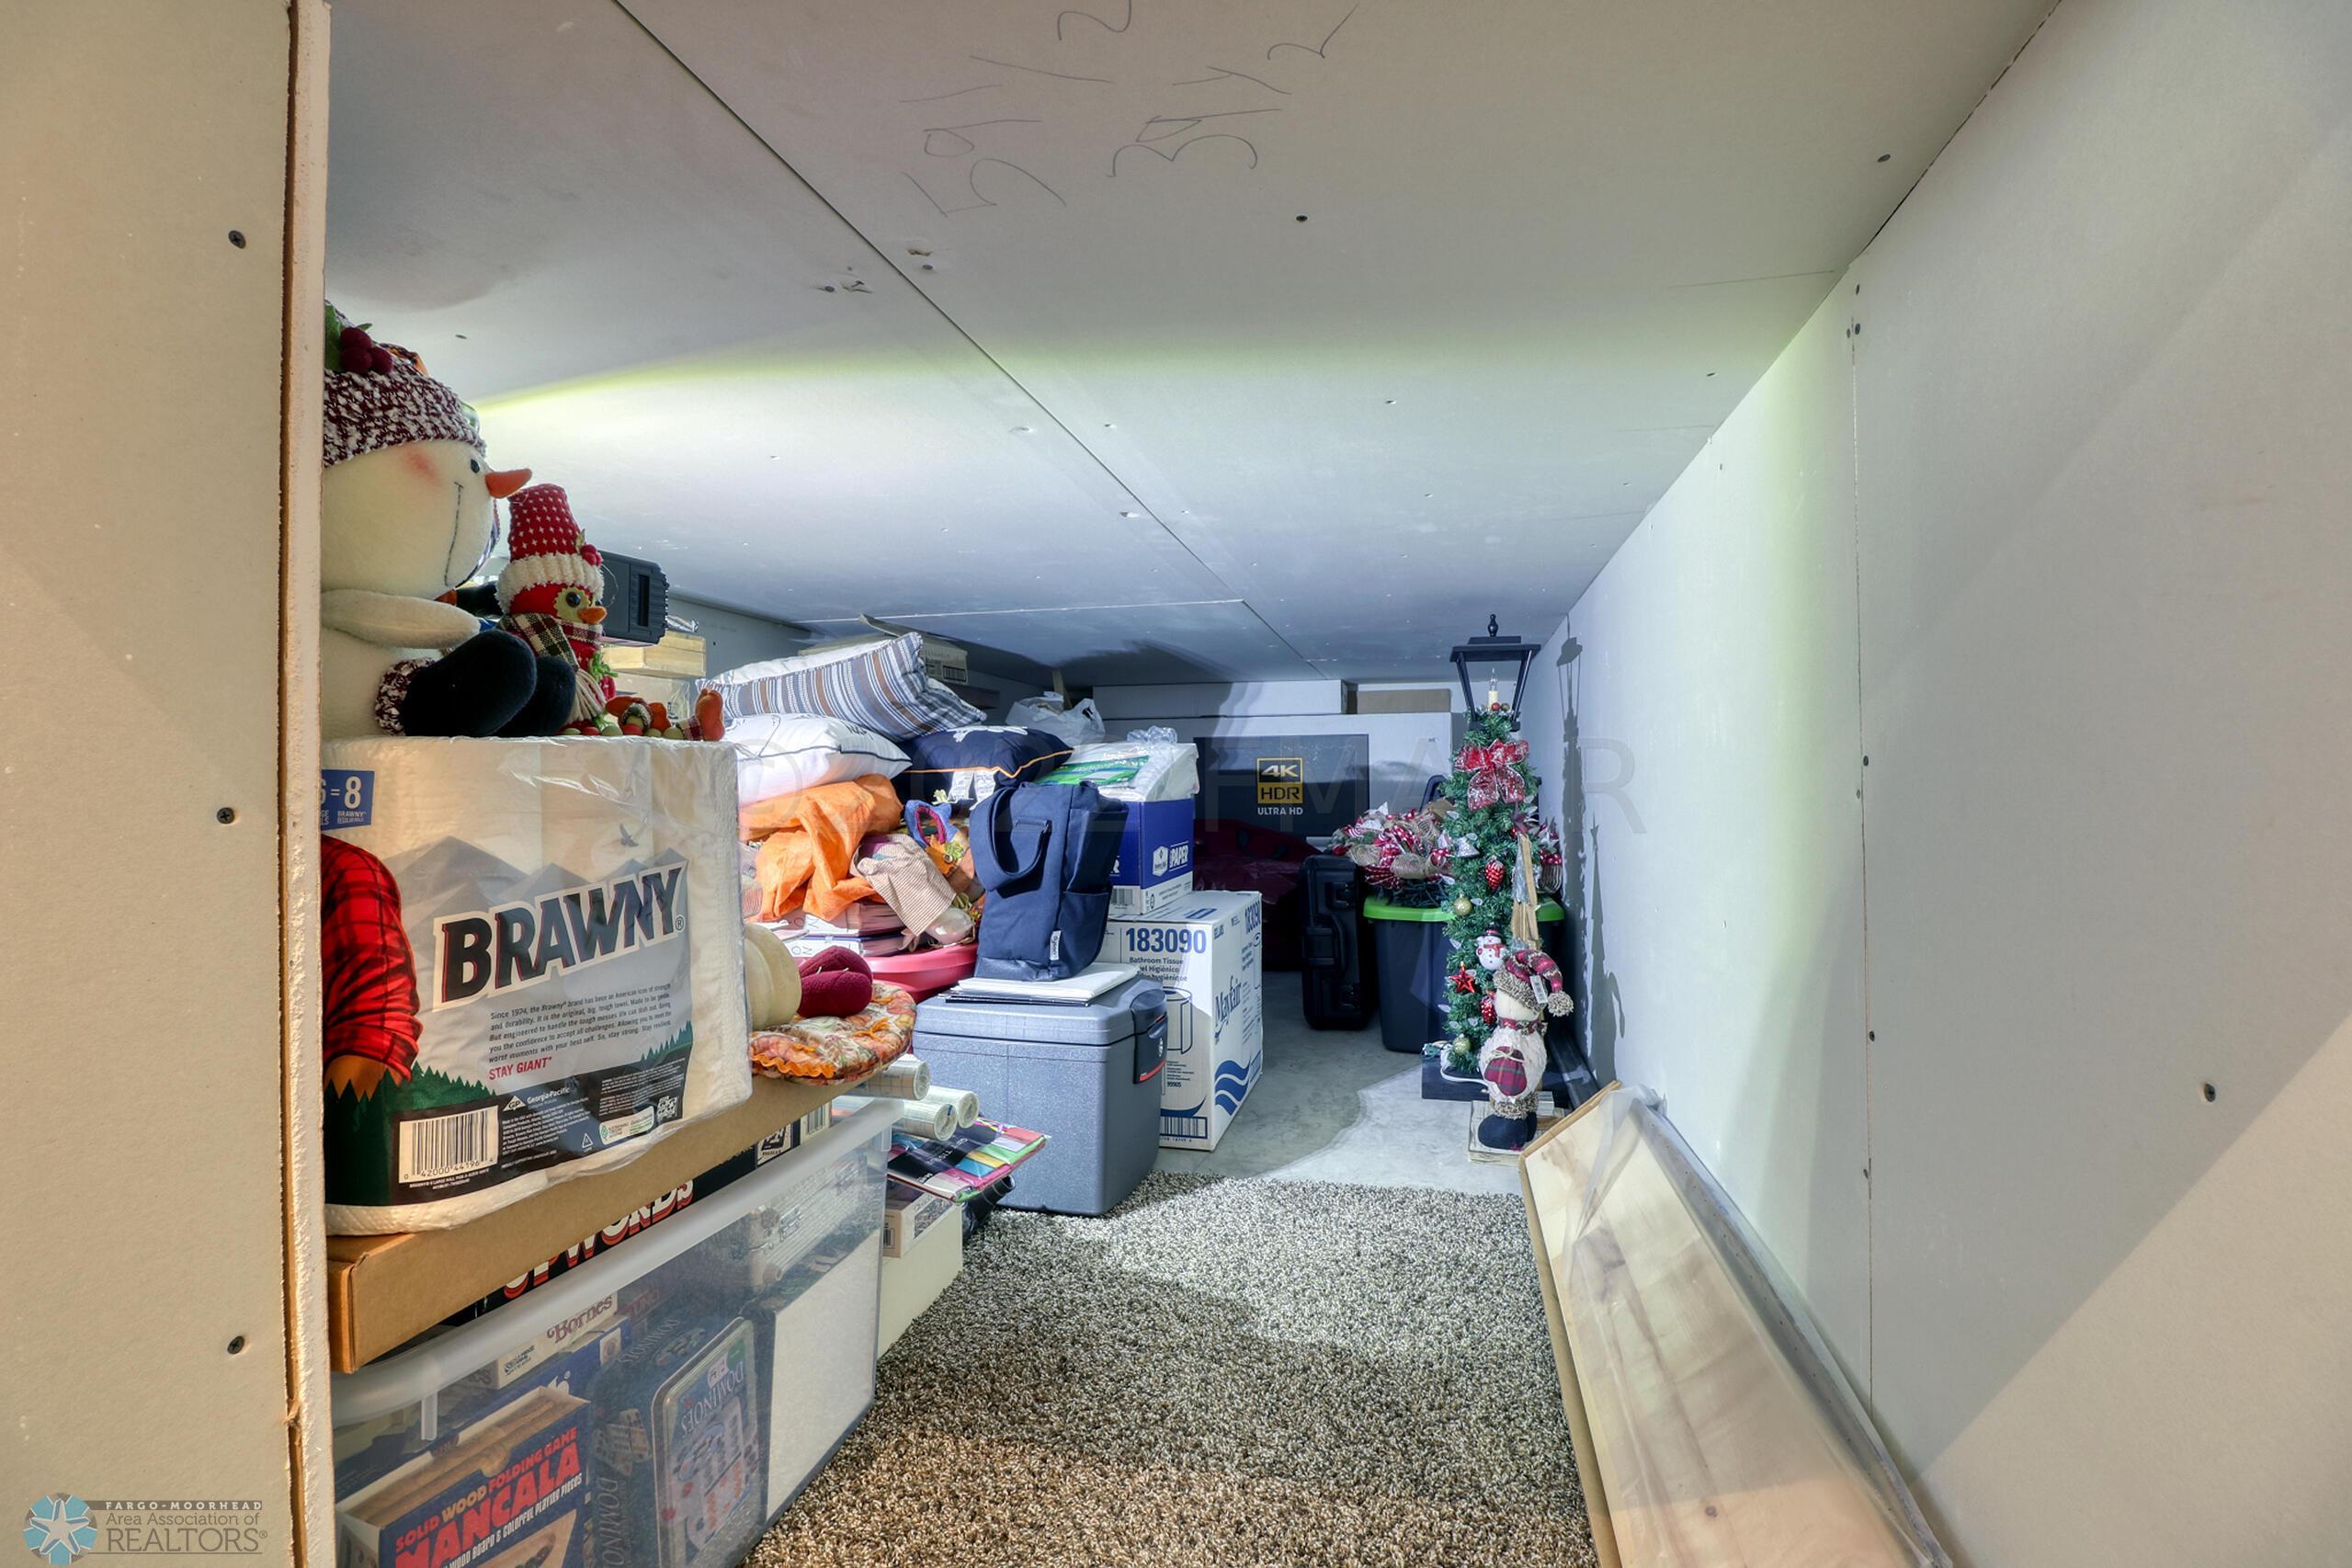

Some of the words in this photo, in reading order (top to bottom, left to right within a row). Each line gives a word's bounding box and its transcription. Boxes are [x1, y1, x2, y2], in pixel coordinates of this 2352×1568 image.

[1261, 765, 1299, 778] 4K
[1261, 787, 1300, 800] HDR
[1257, 807, 1287, 815] ULTRA
[1289, 807, 1303, 815] HD
[1126, 927, 1207, 954] 183090
[489, 1064, 513, 1080] STAY
[528, 1087, 570, 1104] Georgia-Pacific
[547, 1295, 613, 1344] Bornes
[681, 1361, 744, 1438] DOMINOES
[396, 1515, 441, 1552] SOLID
[442, 1483, 486, 1523] WOOD
[488, 1448, 542, 1494] FOLDING
[544, 1426, 578, 1457] GAME
